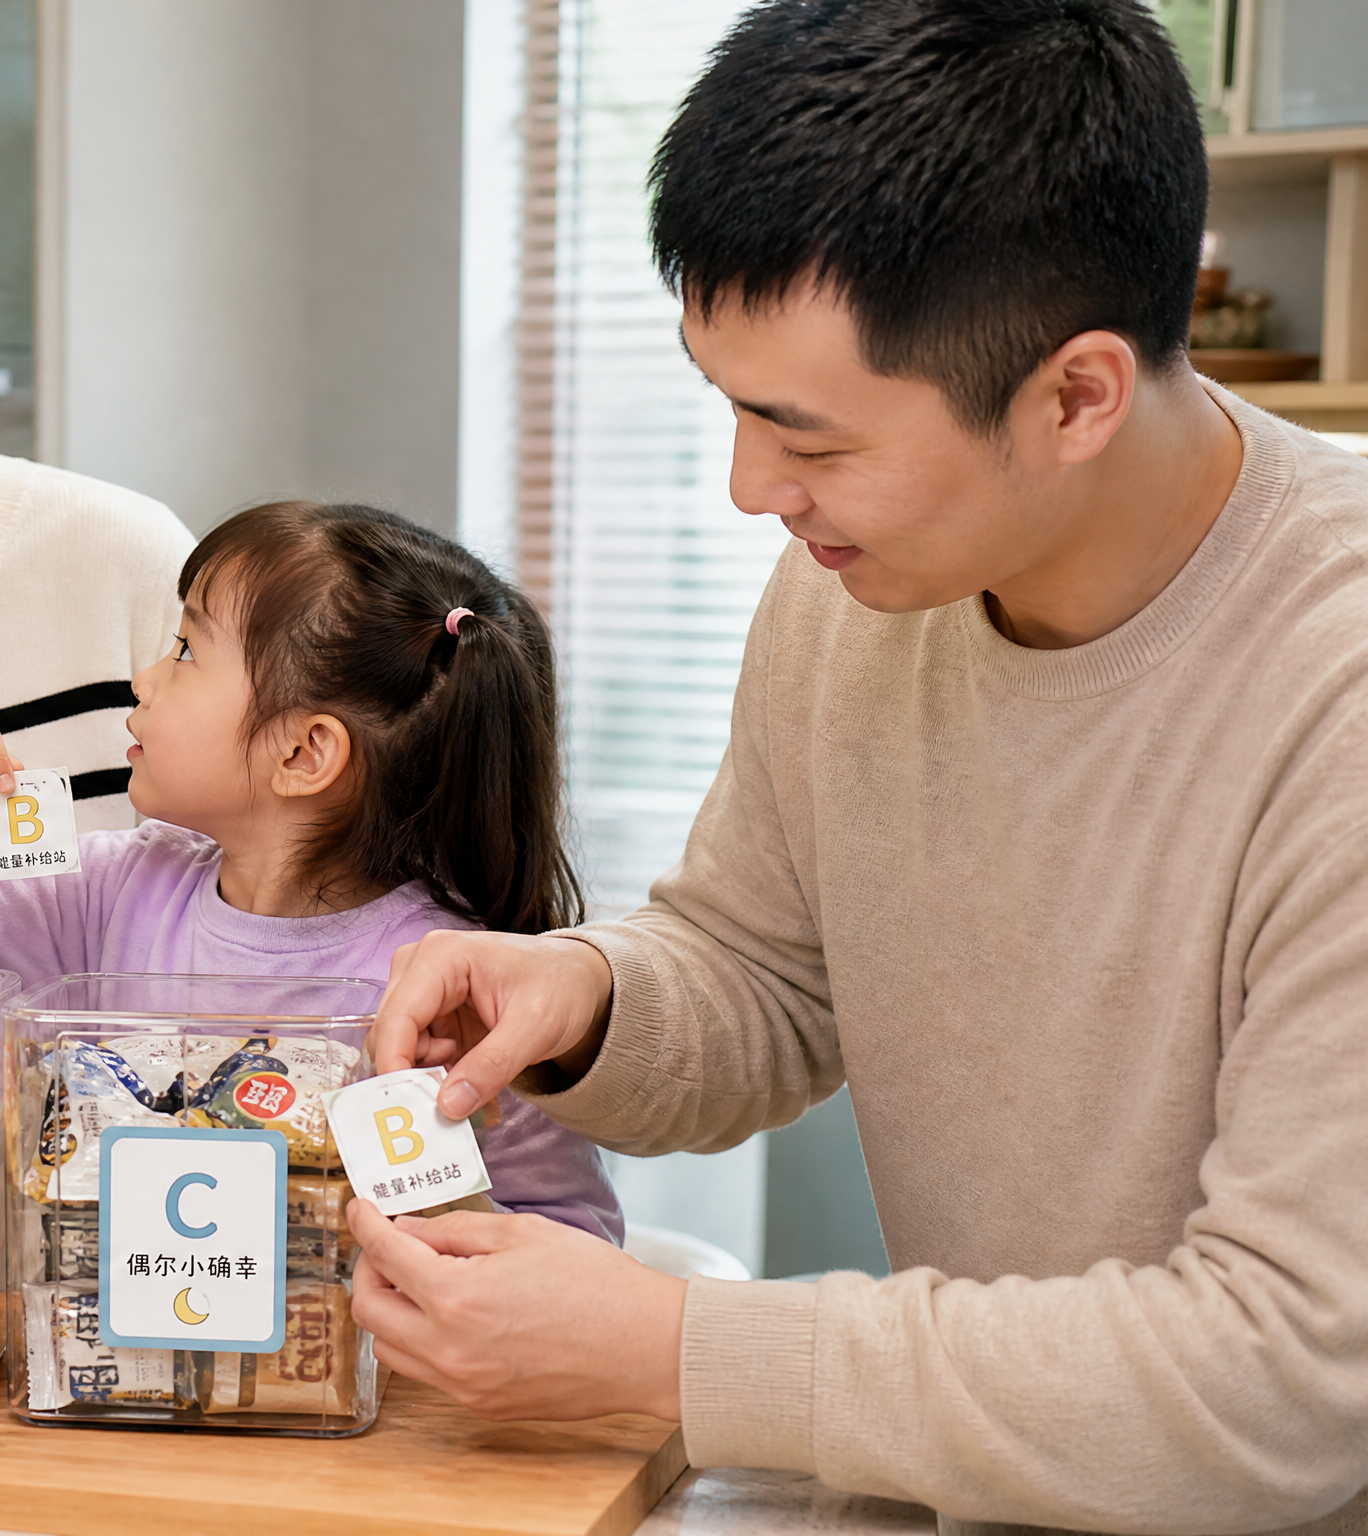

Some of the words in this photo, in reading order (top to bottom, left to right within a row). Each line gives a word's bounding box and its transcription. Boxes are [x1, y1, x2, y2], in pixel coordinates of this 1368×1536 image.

[7, 796, 44, 844] B
[373, 1105, 425, 1166] B
[164, 1172, 219, 1240] C
[126, 1253, 258, 1280] 偶尔小确幸
